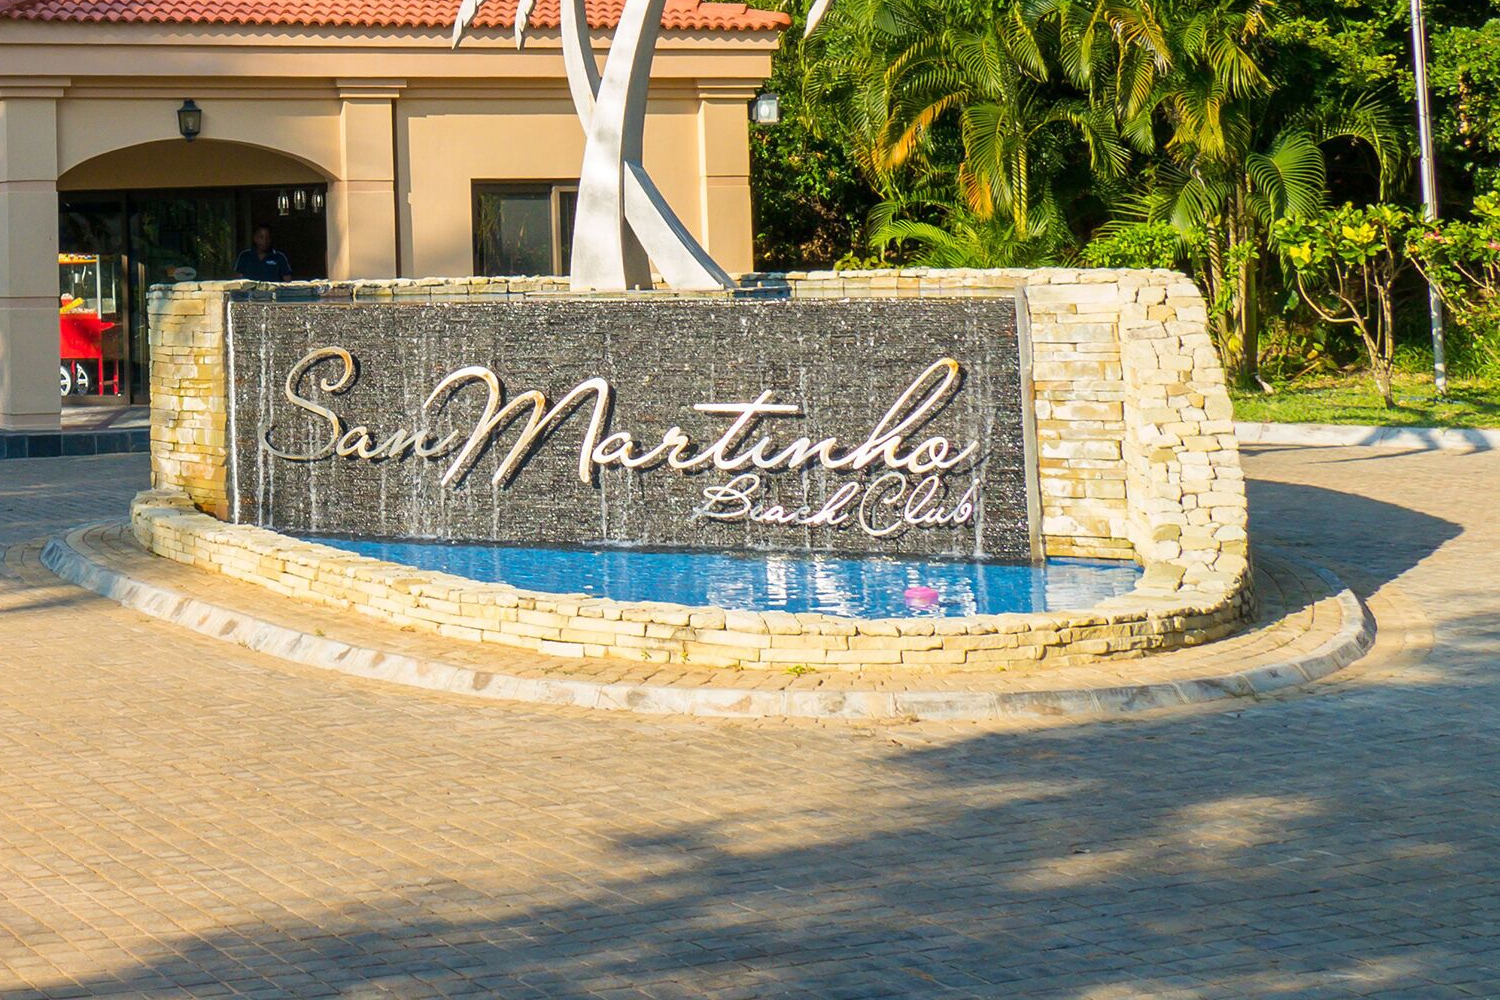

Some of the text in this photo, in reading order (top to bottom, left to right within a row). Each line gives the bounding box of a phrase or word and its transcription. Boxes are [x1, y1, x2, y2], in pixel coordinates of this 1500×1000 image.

[258, 346, 979, 487] San Martinho
[693, 471, 980, 537] Beach Club
